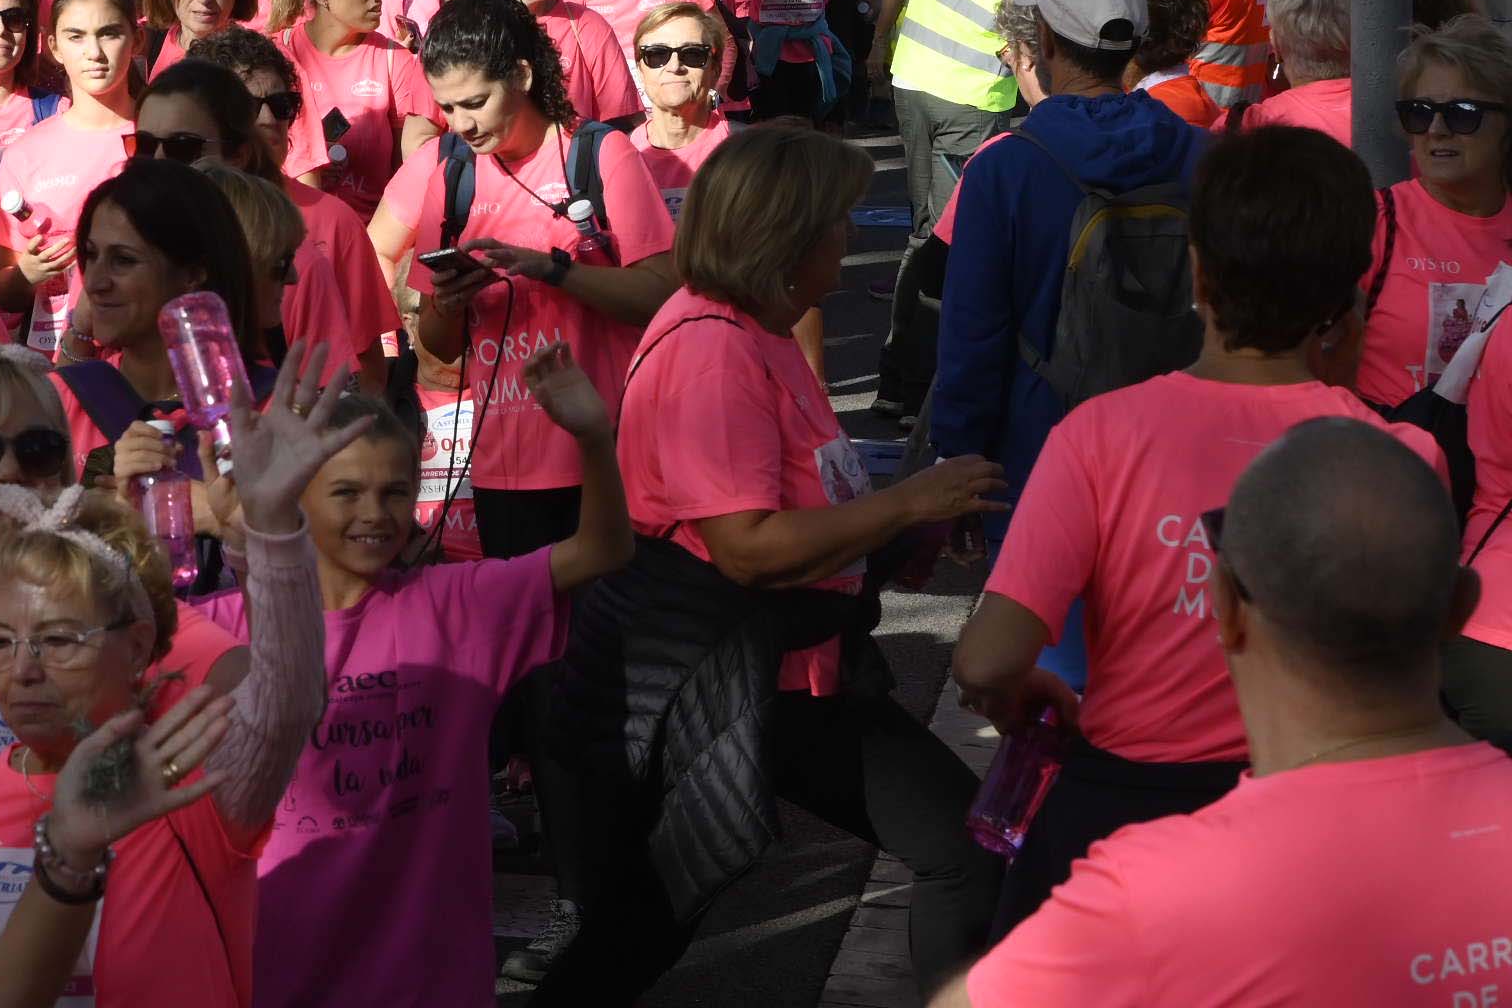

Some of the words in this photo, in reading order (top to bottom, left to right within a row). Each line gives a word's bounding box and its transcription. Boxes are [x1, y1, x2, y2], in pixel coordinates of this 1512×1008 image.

[1156, 515, 1210, 549] CA
[1187, 553, 1210, 583] D
[1410, 936, 1512, 985] CARR
